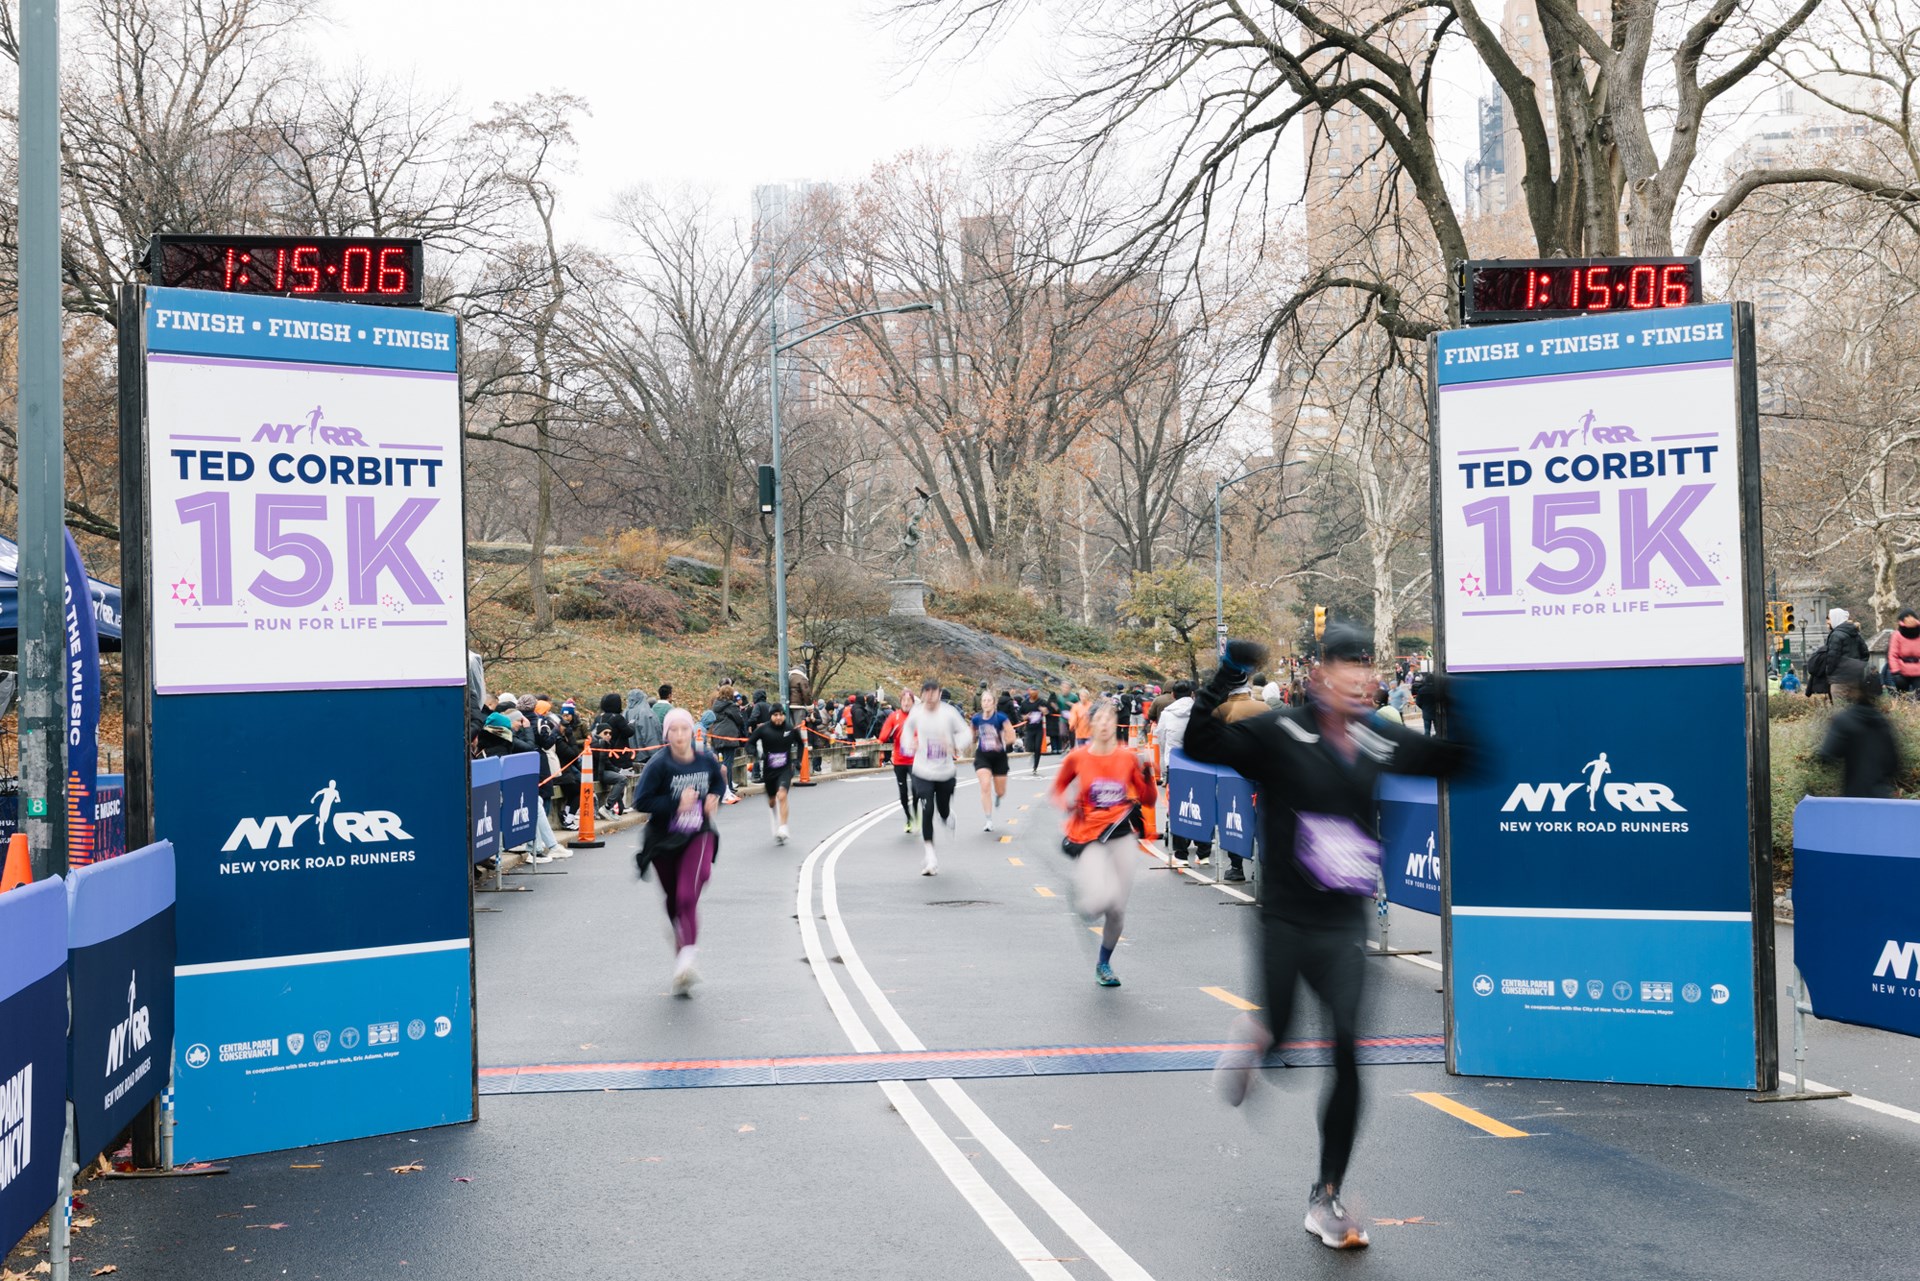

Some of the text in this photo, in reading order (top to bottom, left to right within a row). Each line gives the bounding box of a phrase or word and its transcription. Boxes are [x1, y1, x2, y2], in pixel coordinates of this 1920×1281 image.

[156, 309, 450, 351] FINISH FINISH FINISH
[1444, 322, 1724, 365] FINISH FINISH FINISH
[170, 449, 443, 488] TED CORBITT
[1458, 445, 1719, 489] TED CORBITT
[174, 490, 446, 608] 15K
[1461, 482, 1722, 597] 15K
[1530, 599, 1649, 617] RUN FOR LIFE
[66, 604, 81, 657] THE
[254, 617, 378, 631] RUN FOR LIFE
[70, 659, 83, 746] MUSIC
[32, 799, 43, 813] 8
[100, 799, 120, 820] MUSIC
[1500, 821, 1689, 833] NEW YORK ROAD RUNNERS
[219, 850, 416, 875] NEW YORK ROAD RUNNERS
[1501, 979, 1549, 988] CENTRAL PARK
[1501, 986, 1549, 996] CONSERVANCY
[1872, 982, 1920, 998] NEW YO
[1711, 989, 1726, 1000] MTA
[219, 1039, 272, 1054] CENTRAL PARK
[219, 1047, 272, 1062] CONSERVANCY
[252, 1065, 285, 1075] cooperation
[0, 1068, 24, 1138] PARK
